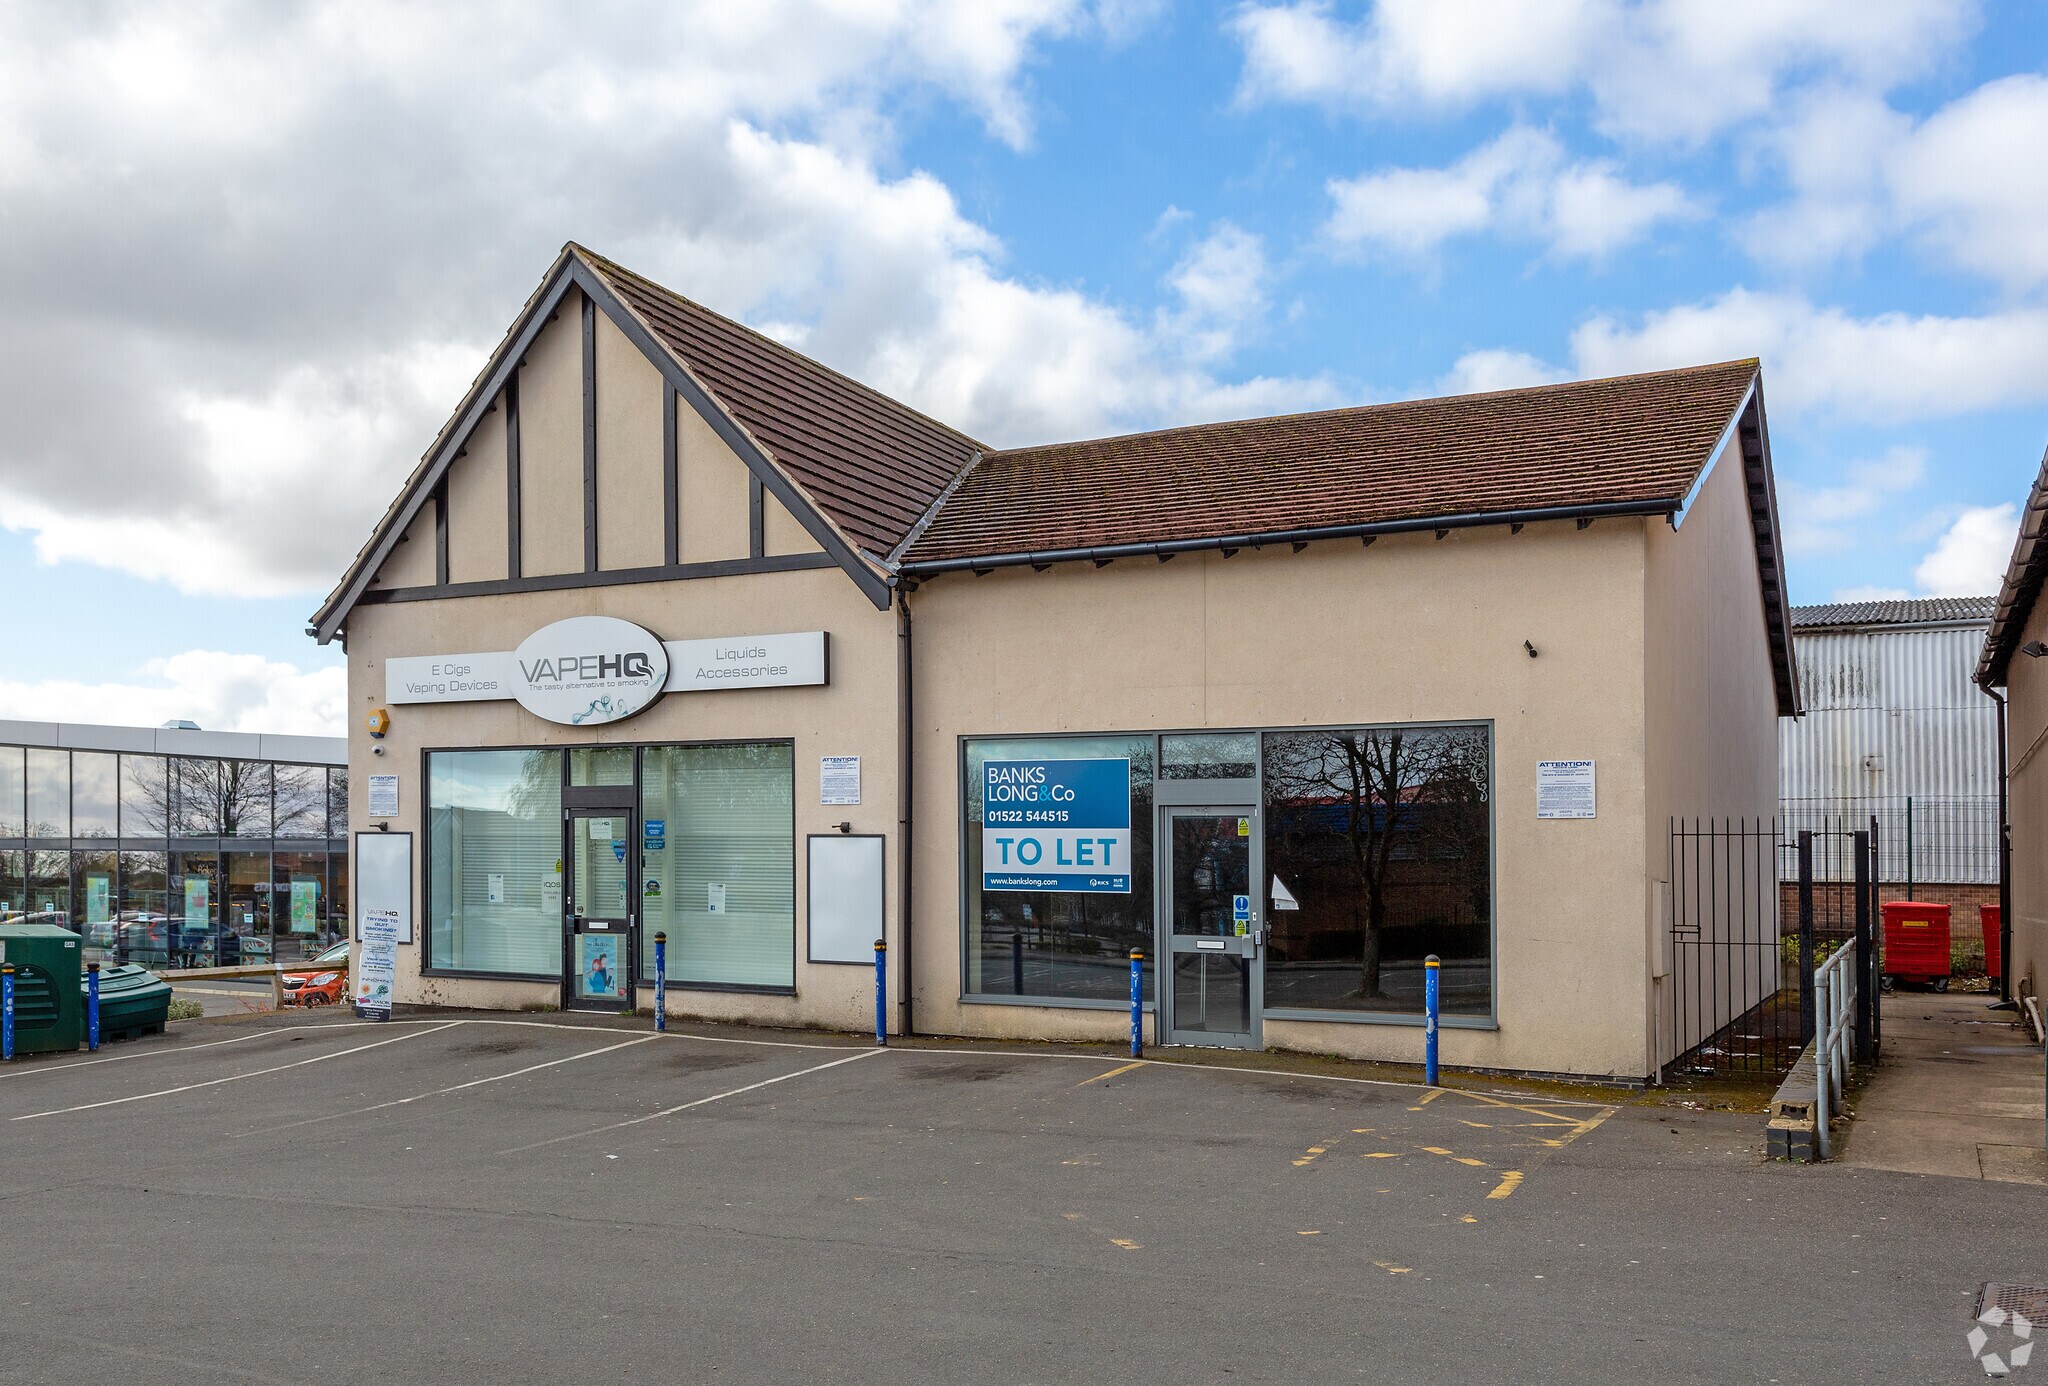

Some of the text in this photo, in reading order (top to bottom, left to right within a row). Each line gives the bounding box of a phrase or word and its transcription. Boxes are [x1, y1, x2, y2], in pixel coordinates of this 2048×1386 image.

[716, 646, 766, 661] Liquids
[432, 664, 471, 677] E Cigs
[695, 663, 788, 680] Accessories
[406, 679, 498, 694] Vaping Devices
[543, 683, 564, 691] tasty
[565, 681, 604, 689] alternative
[618, 678, 649, 688] smoking
[988, 766, 1046, 784] BANKS
[988, 784, 1075, 802] LONG&Co
[989, 811, 1069, 822] 01522 544515
[995, 837, 1117, 866] TO LET
[990, 877, 1058, 887] www.bankslong.com
